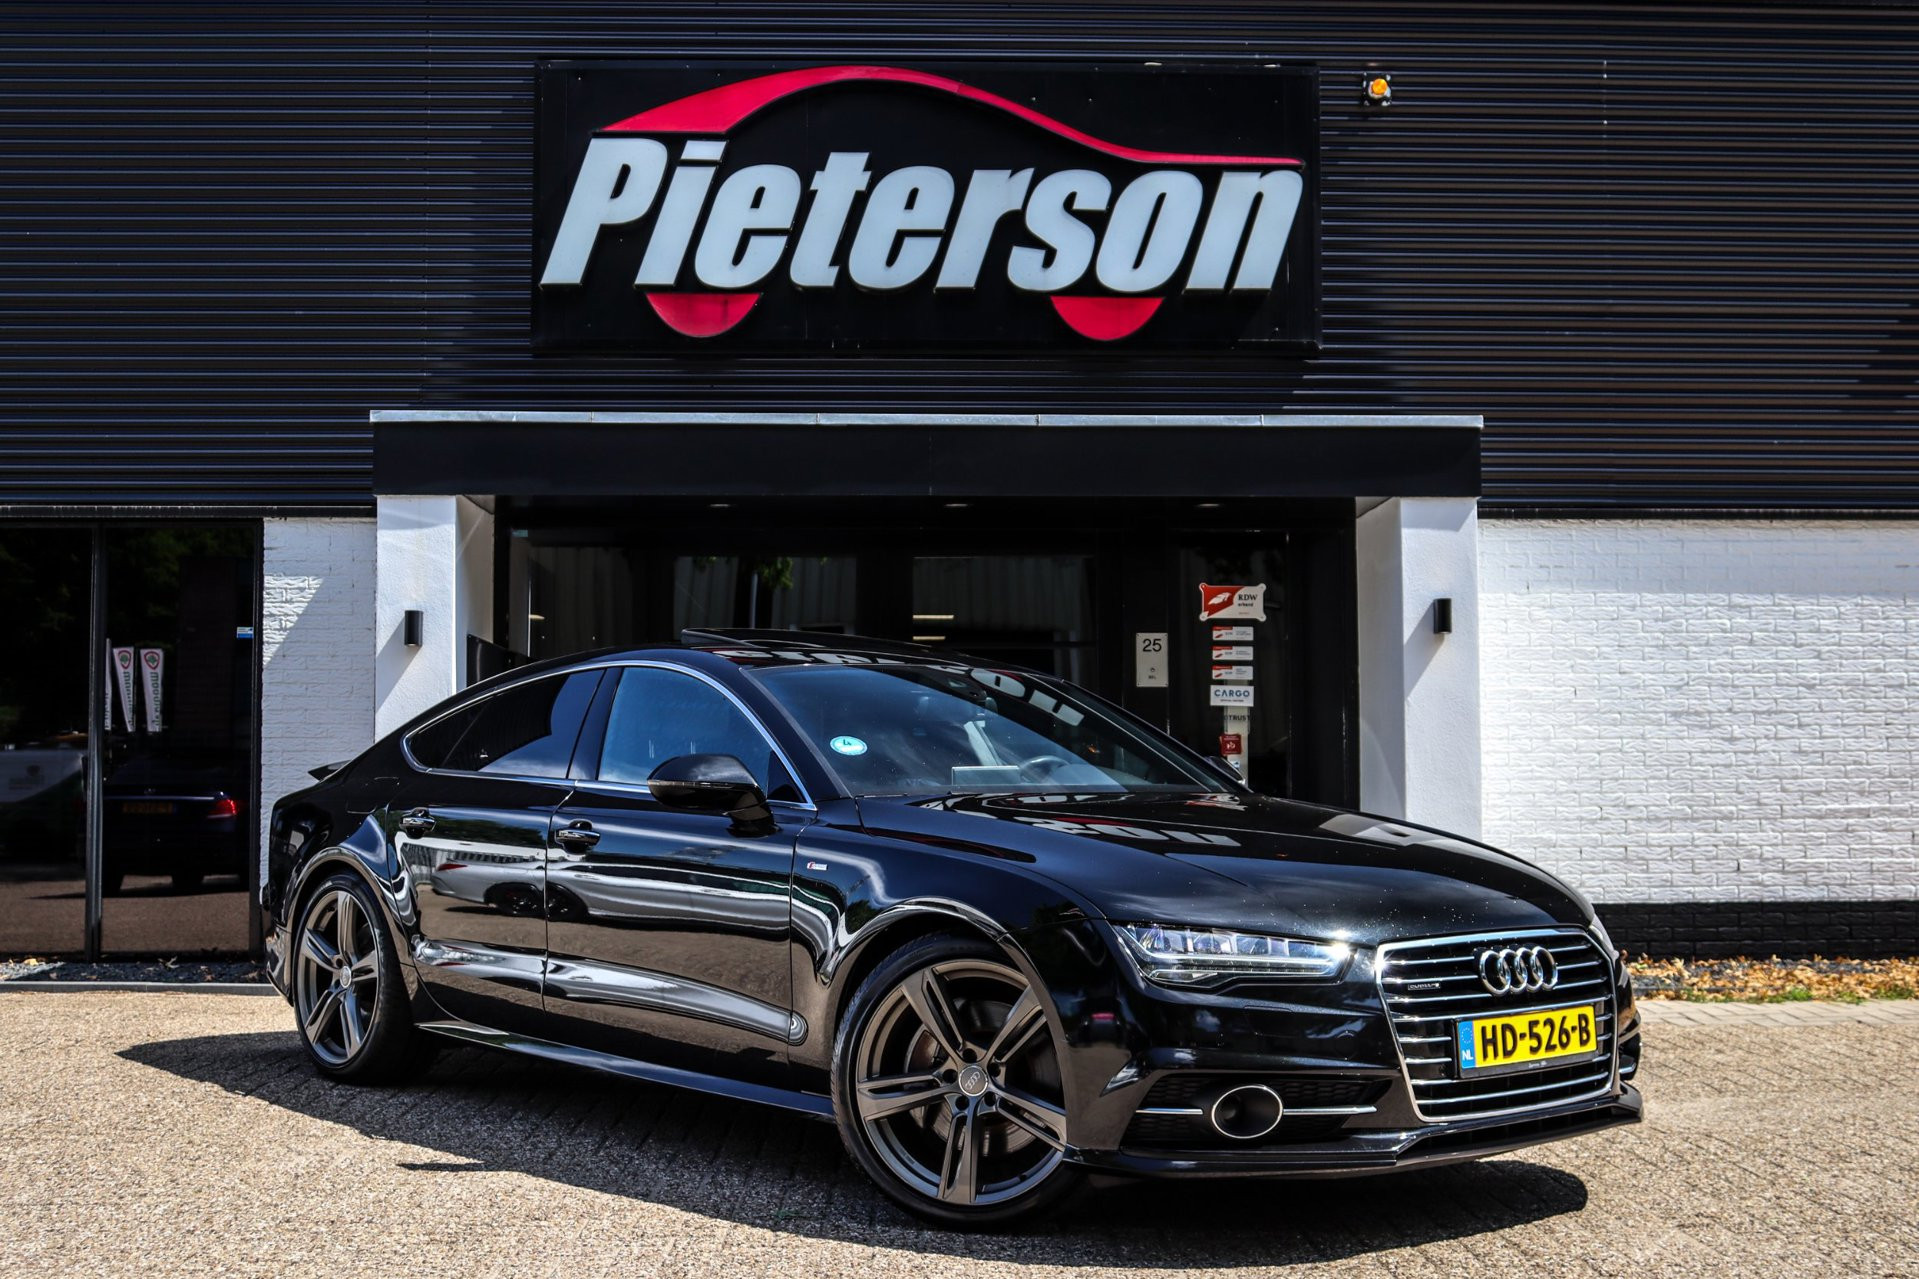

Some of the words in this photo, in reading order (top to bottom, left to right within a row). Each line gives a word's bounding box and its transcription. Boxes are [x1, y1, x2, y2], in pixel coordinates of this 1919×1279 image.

[540, 137, 1304, 293] Pieterson
[1238, 593, 1258, 601] RDW
[1142, 638, 1162, 652] 25
[1214, 689, 1250, 698] CARGO
[1481, 1013, 1592, 1062] HD-526-B
[1461, 1049, 1474, 1061] NL
